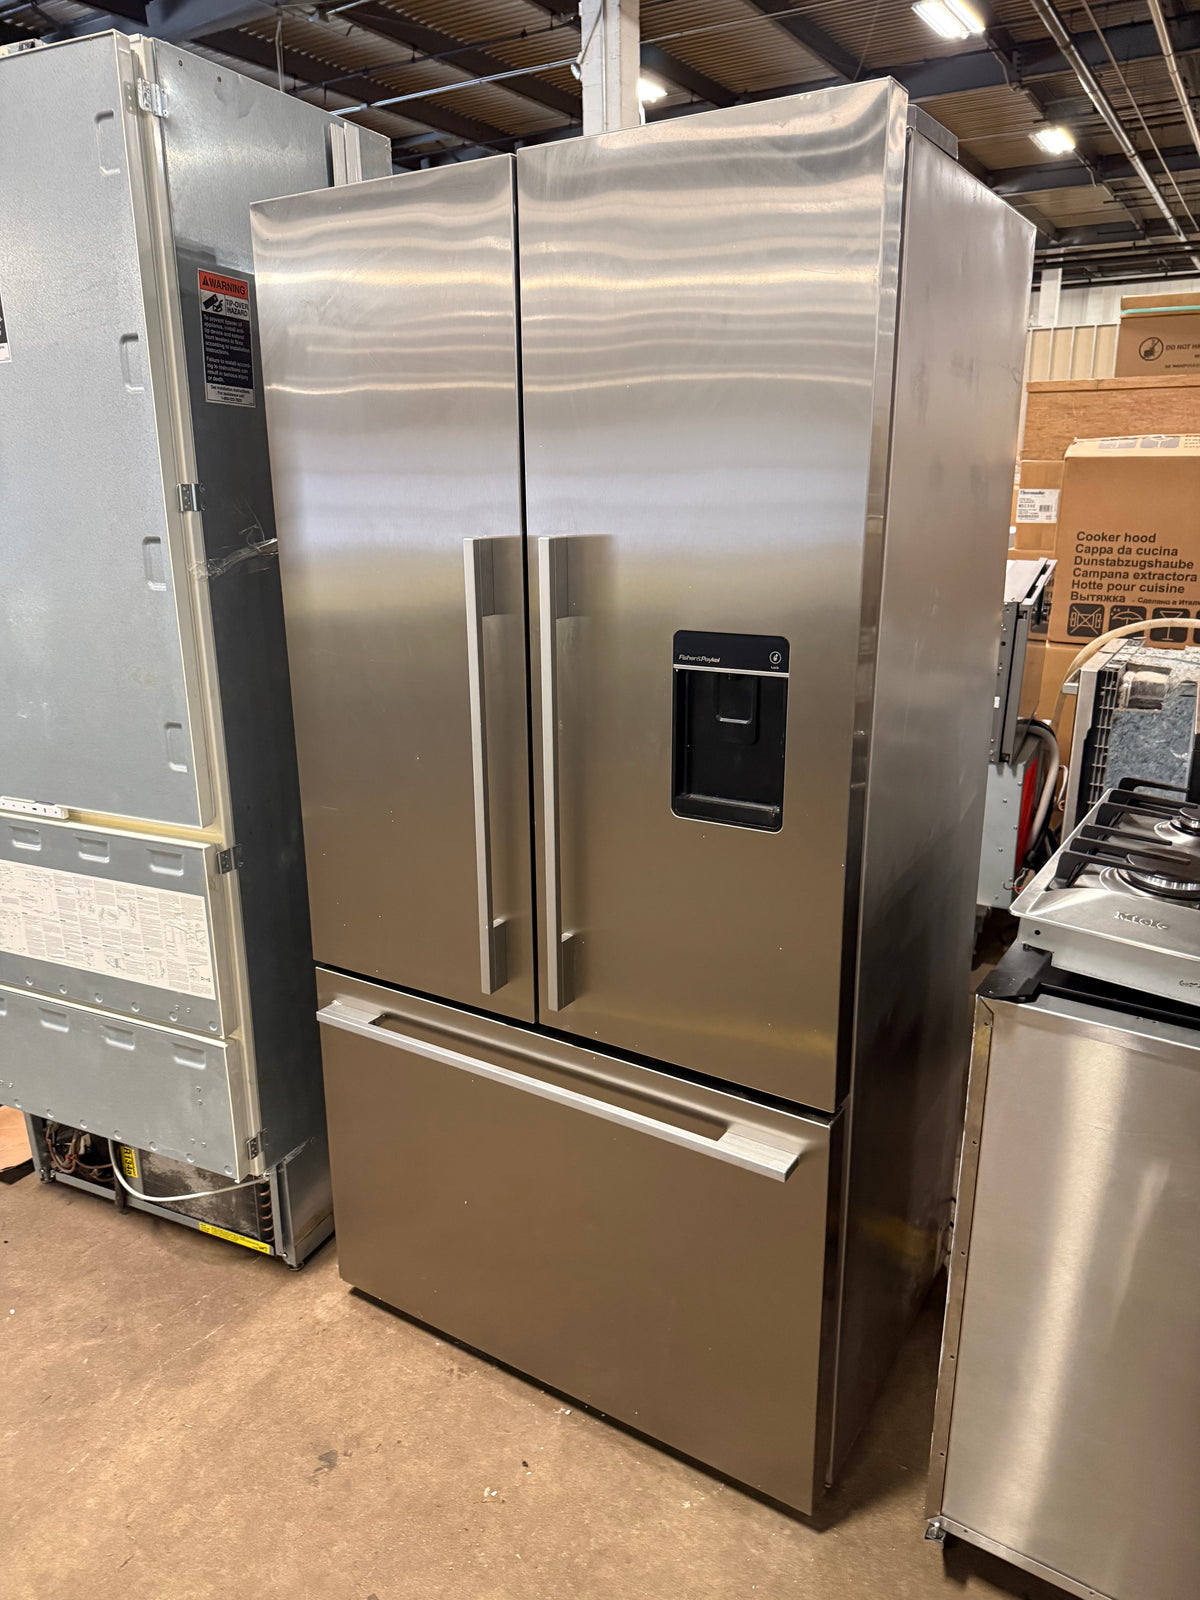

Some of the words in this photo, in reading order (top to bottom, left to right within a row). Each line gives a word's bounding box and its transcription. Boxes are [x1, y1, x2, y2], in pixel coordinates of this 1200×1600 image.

[208, 277, 246, 295] WARNING
[225, 299, 248, 310] TIP-OVER
[227, 306, 249, 317] HAZARD
[1076, 531, 1120, 542] Cooker
[1124, 532, 1156, 543] hood
[1075, 544, 1113, 556] Cappa
[1117, 545, 1132, 555] da
[1136, 546, 1178, 556] cucina
[1074, 556, 1194, 570] Dunstabzugshaube
[1073, 568, 1129, 580] Campana
[1133, 571, 1197, 582] extractora
[1071, 580, 1103, 590] Hotte
[1106, 583, 1136, 593] pour
[1139, 582, 1185, 594] cuisine
[1070, 591, 1126, 603] Вытяжка
[678, 654, 721, 663] Fisher&Paykel
[1114, 911, 1168, 930] Miele
